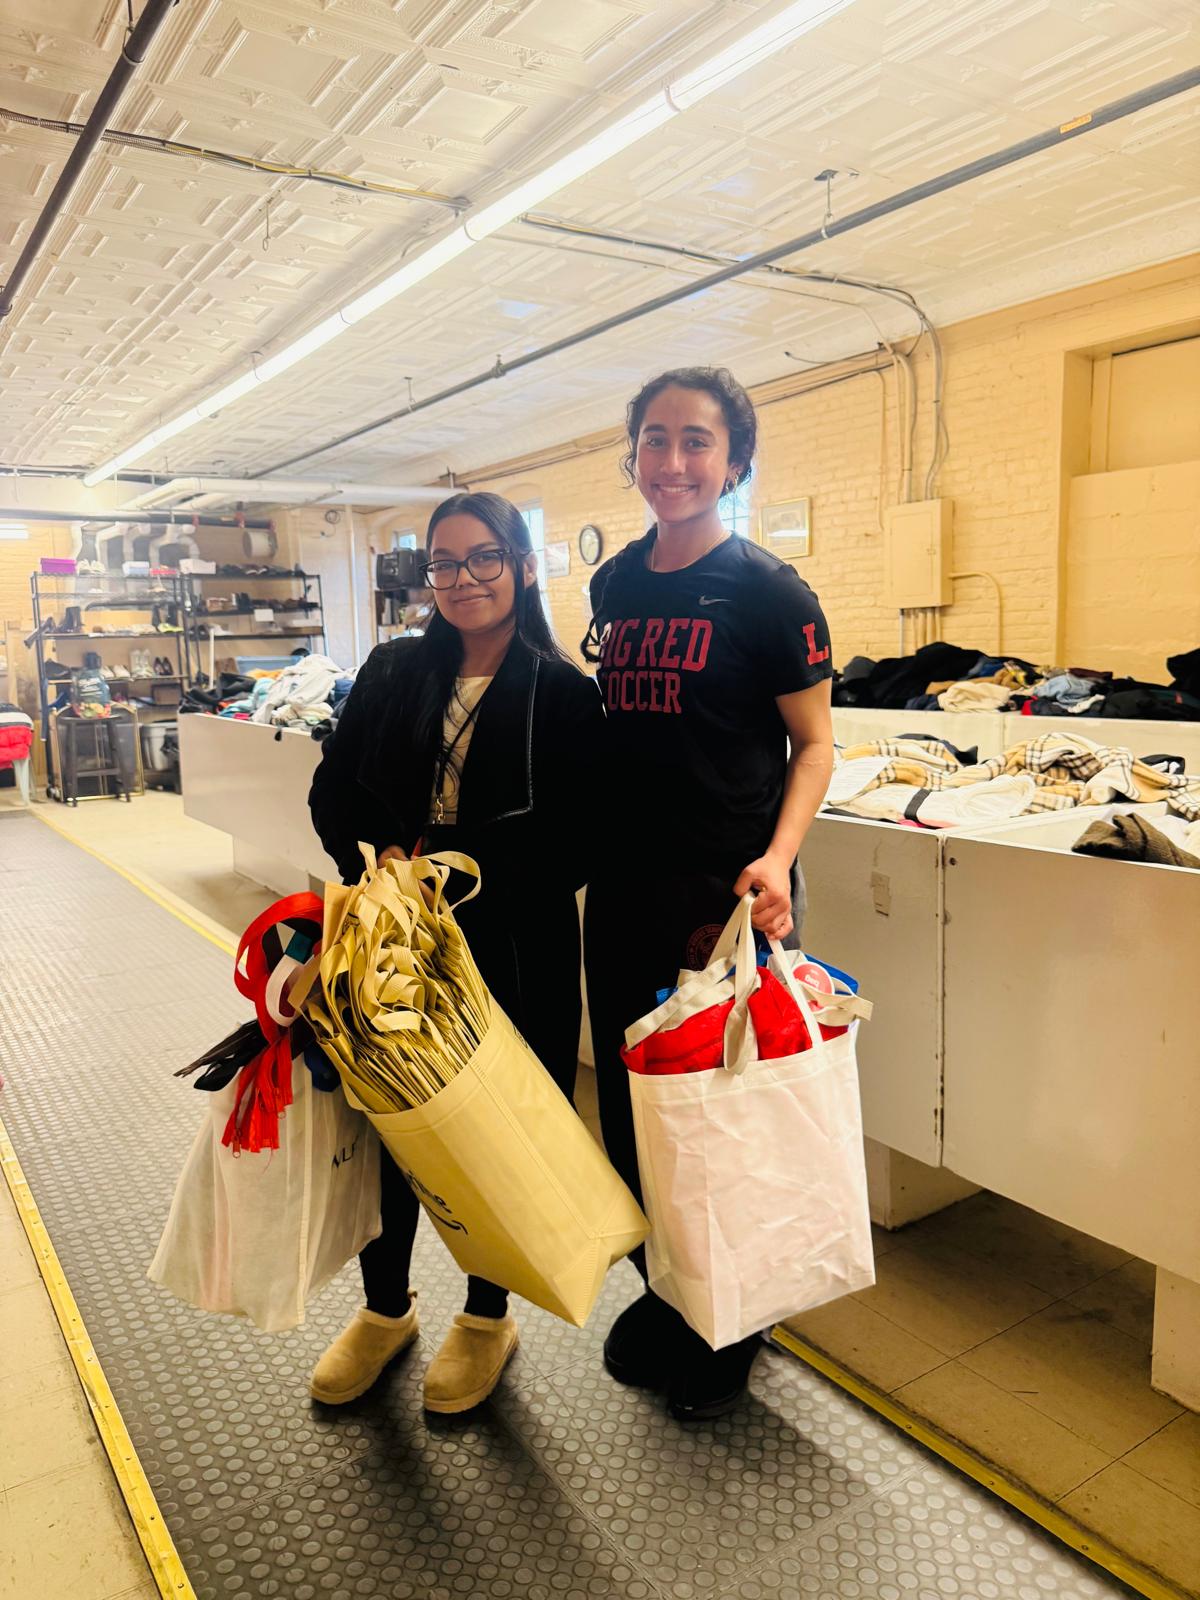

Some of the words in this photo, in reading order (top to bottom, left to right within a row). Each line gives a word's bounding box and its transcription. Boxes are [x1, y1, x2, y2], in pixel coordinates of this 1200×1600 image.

[600, 619, 640, 668] IG
[636, 617, 713, 672] RED
[802, 622, 829, 666] L
[602, 670, 682, 714] OCCER
